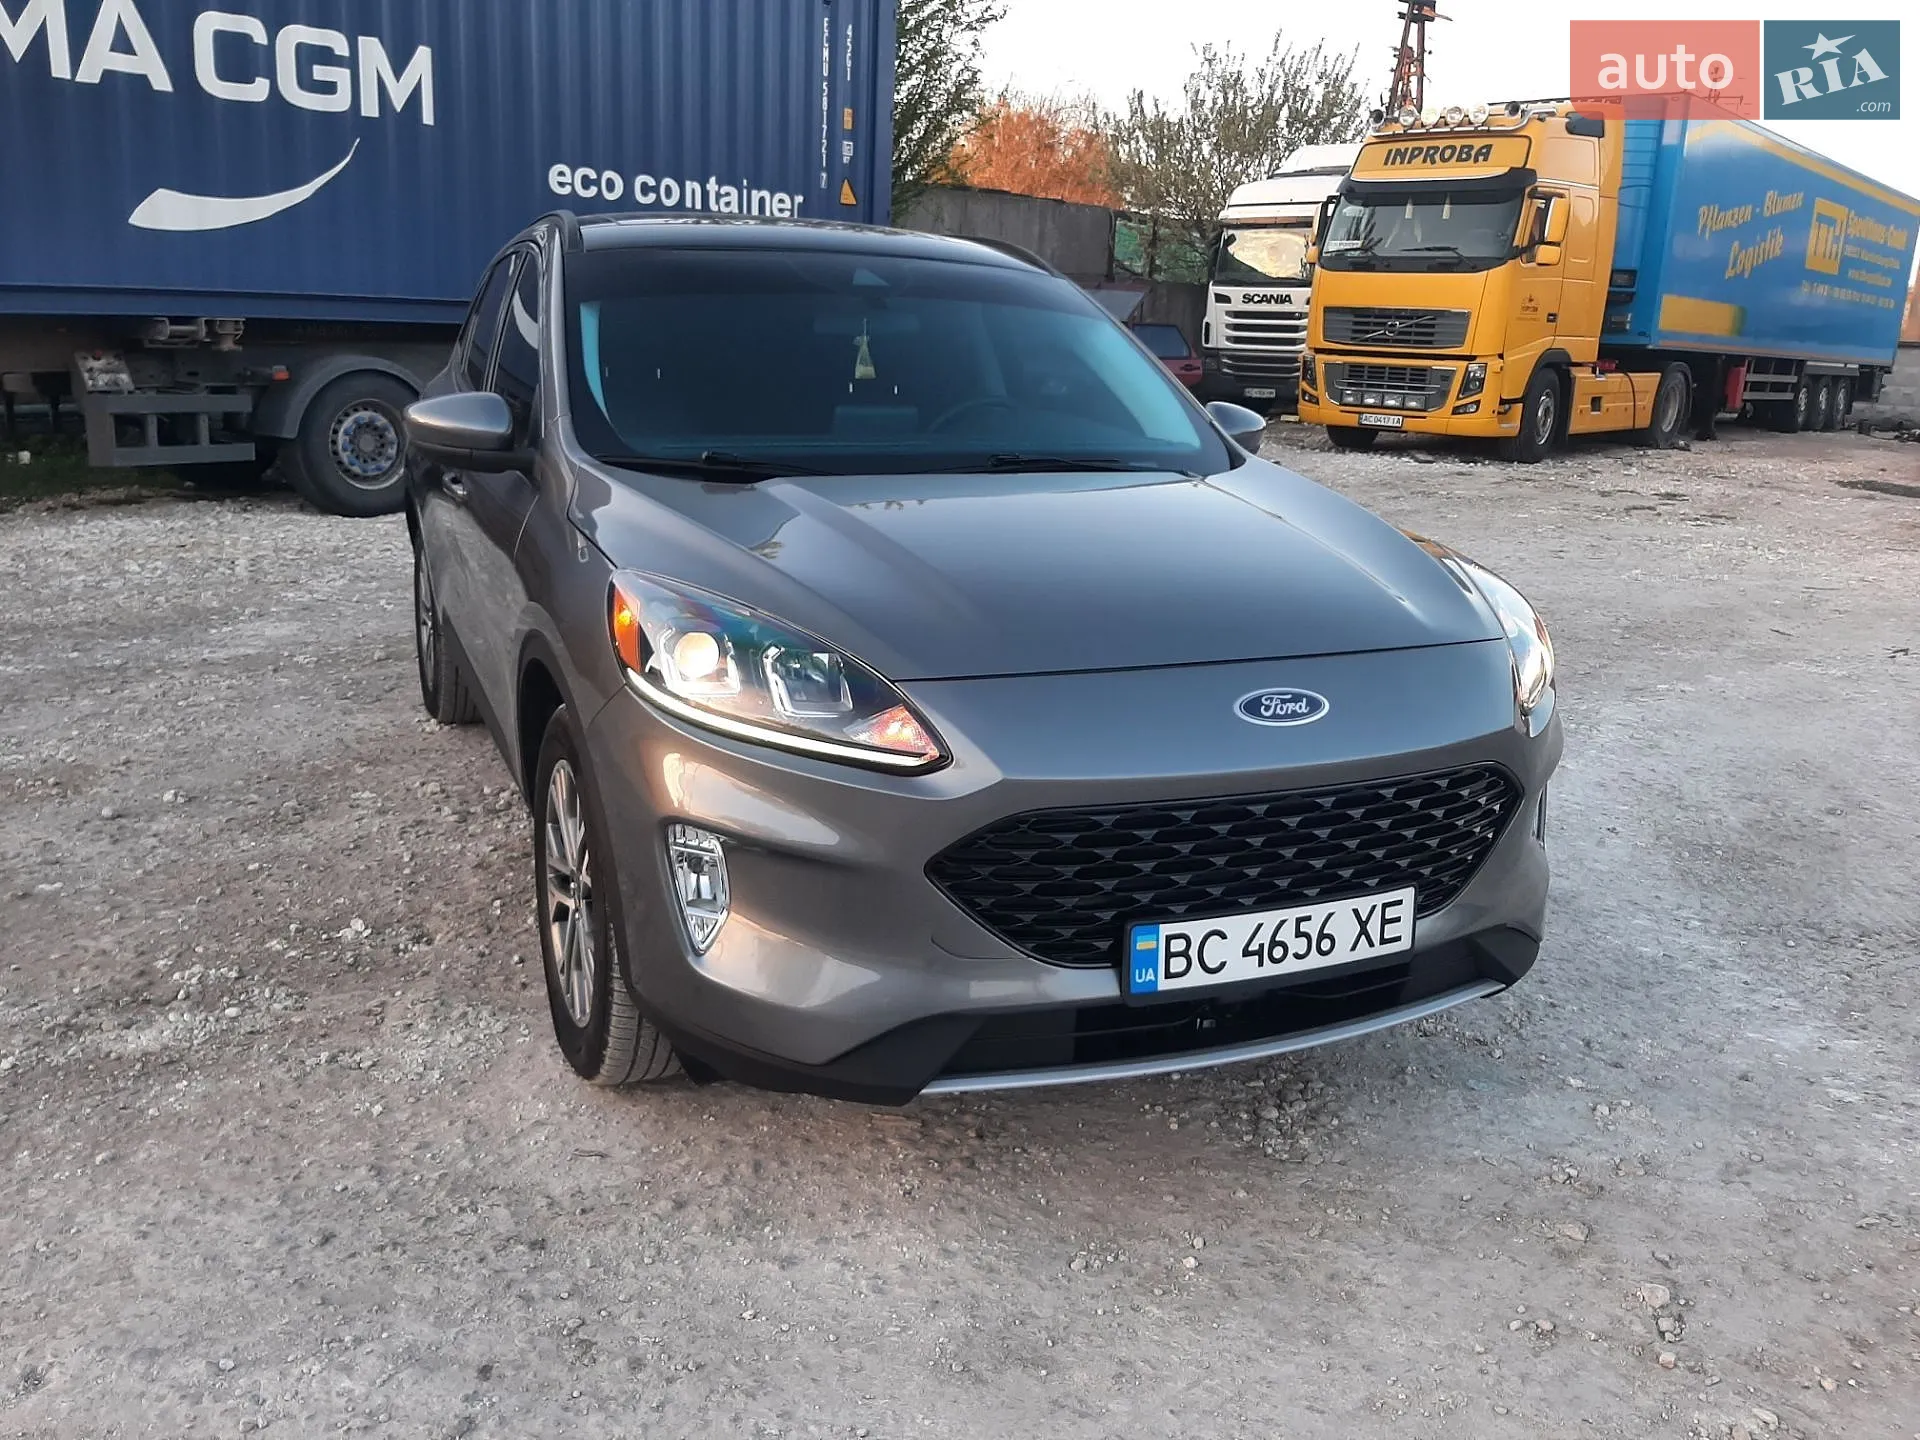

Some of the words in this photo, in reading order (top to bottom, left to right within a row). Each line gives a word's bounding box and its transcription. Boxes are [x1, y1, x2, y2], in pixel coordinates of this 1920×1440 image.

[194, 11, 435, 126] CGM
[1384, 143, 1493, 167] INPROBA
[548, 163, 624, 201] eco
[634, 174, 804, 218] container
[1698, 204, 1753, 240] Pflanzen
[1763, 189, 1804, 217] Blumen
[1725, 225, 1783, 280] Logistik
[1241, 292, 1293, 305] SCANIA
[1260, 693, 1309, 717] Ford
[1135, 968, 1155, 984] UA
[1164, 929, 1228, 979] BC
[1242, 911, 1336, 968] 4656
[1350, 899, 1404, 952] XE
